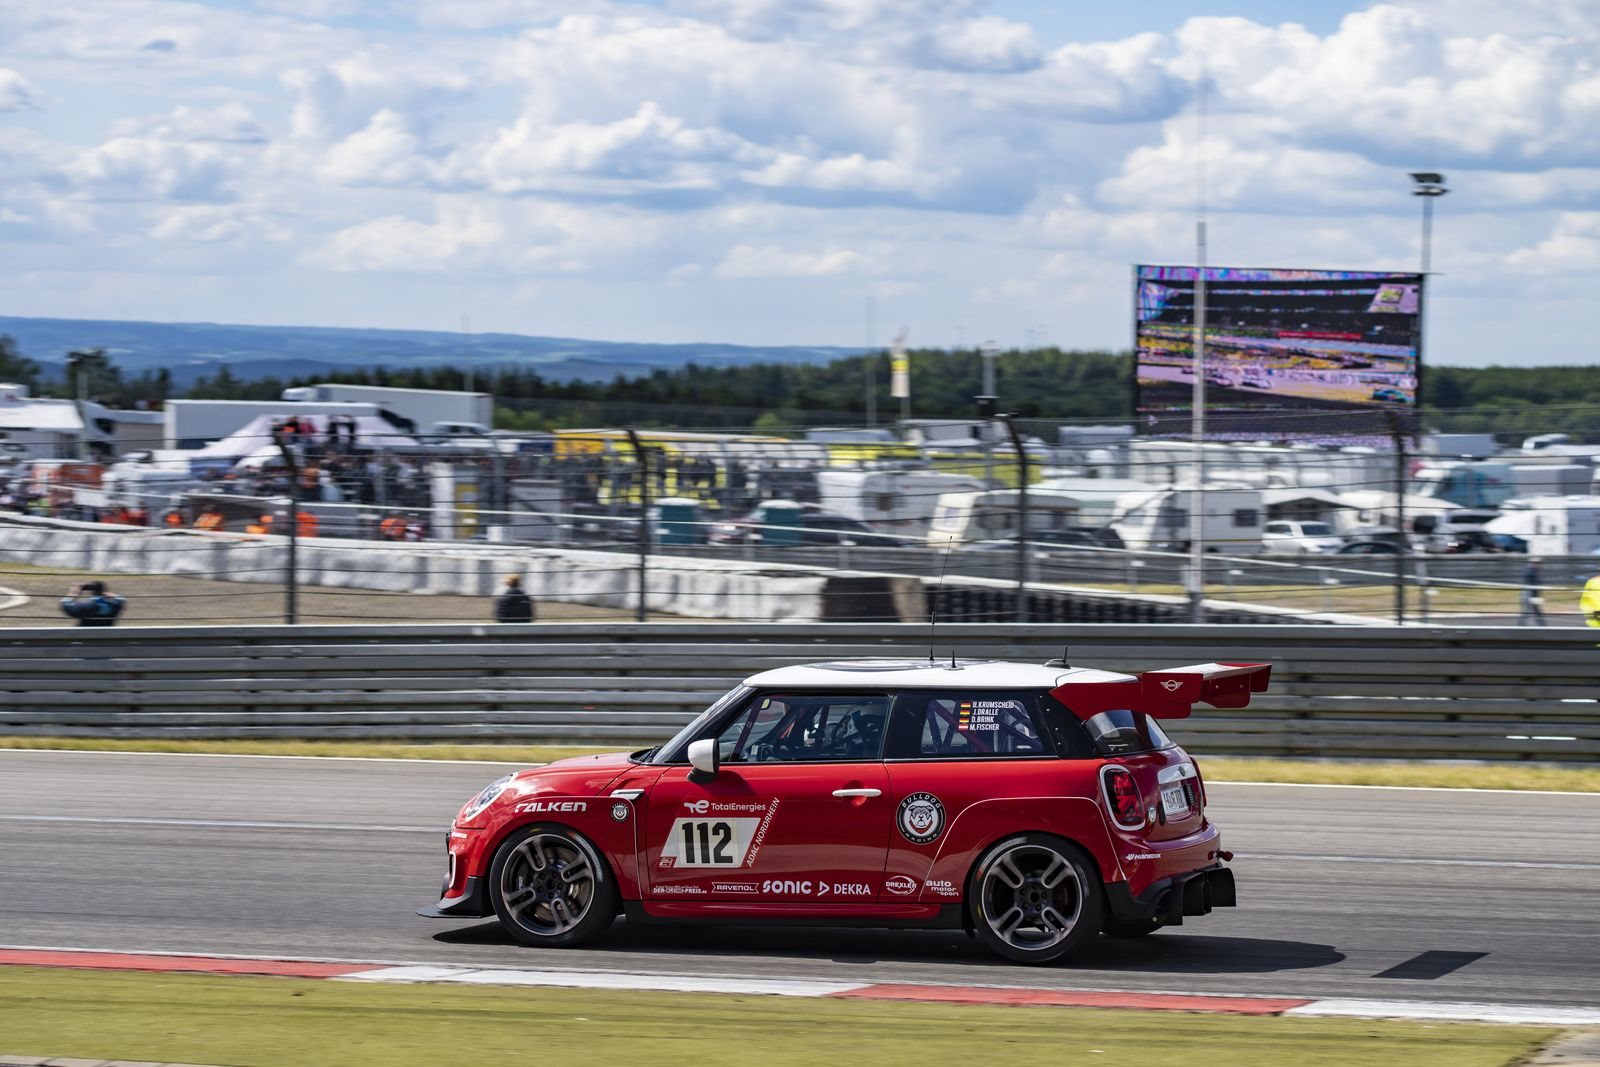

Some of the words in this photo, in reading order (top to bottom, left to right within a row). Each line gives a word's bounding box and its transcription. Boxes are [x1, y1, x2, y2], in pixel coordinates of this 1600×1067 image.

[514, 801, 587, 813] FALKEN
[711, 802, 766, 812] TotalEnergies
[901, 794, 941, 808] BULLDOG
[745, 843, 760, 868] ADAC
[755, 797, 780, 846] NORDRHEIN
[682, 822, 734, 864] 112
[833, 883, 872, 895] DEKRA
